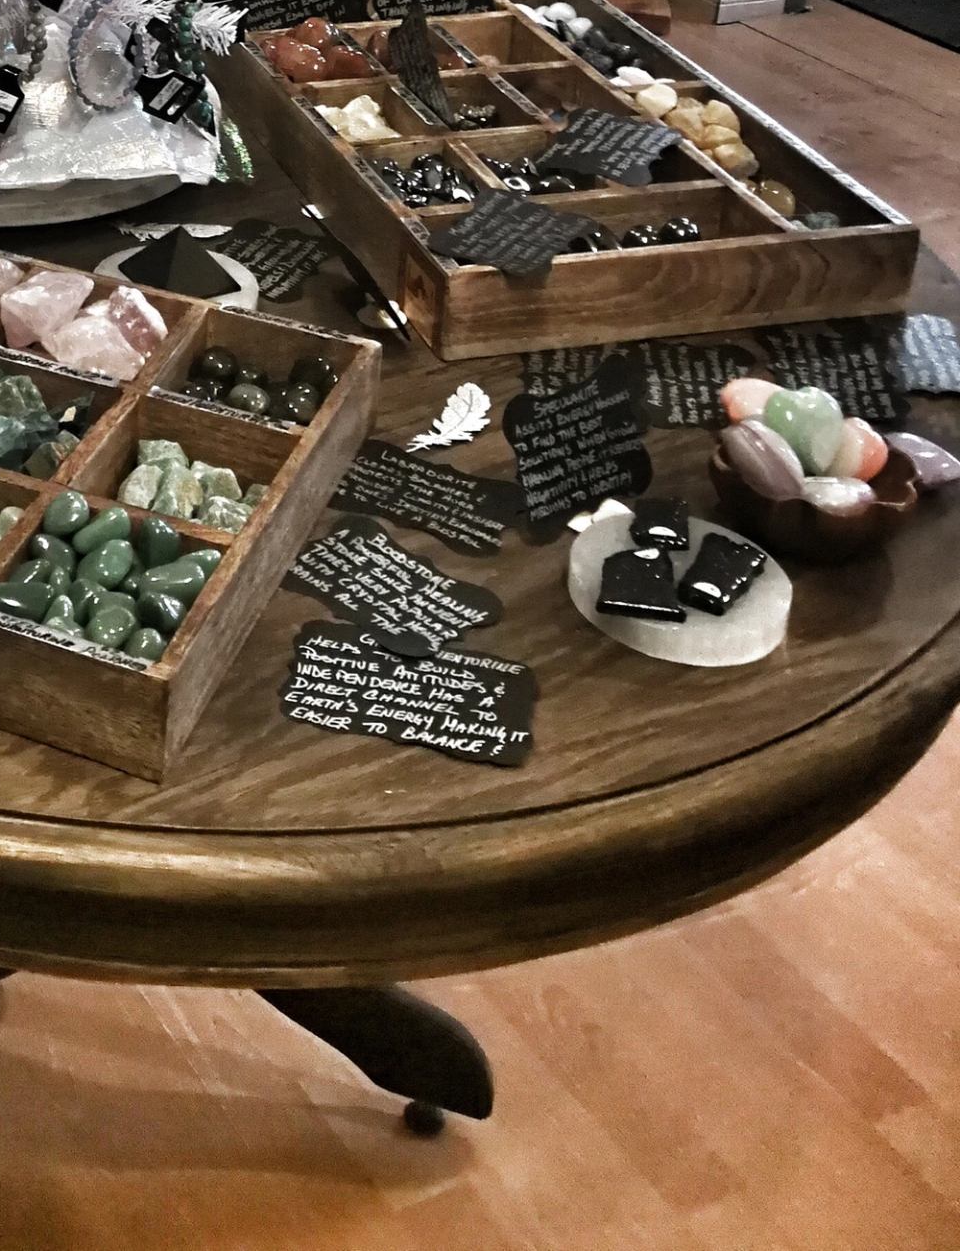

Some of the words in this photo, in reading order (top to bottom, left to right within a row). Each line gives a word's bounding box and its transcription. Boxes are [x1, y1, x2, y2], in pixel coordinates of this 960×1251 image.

[532, 432, 556, 449] FIND
[556, 426, 577, 442] THE
[380, 449, 478, 490] LABRADORITE
[407, 483, 435, 497] THE
[322, 536, 369, 567] STONE
[369, 566, 413, 594] SINCE
[408, 593, 474, 630] ANCIENT
[334, 528, 351, 539] A
[348, 536, 414, 586] POWERFUL
[418, 581, 490, 624] HEALING
[366, 532, 458, 591] BLOODSTONE
[299, 552, 336, 577] WITH
[338, 577, 403, 623] CRYSTAL
[354, 570, 390, 597] VERY
[389, 594, 459, 641] POPULAR
[334, 593, 360, 611] ALL
[371, 612, 409, 636] THE
[299, 645, 381, 673] POSITIVE
[393, 664, 487, 694] ATTITUDES
[306, 634, 361, 655] HELPS
[372, 651, 403, 663] TO
[415, 661, 476, 680] BUILD
[290, 677, 357, 698] DIRECT
[362, 689, 460, 716] CHANNEL
[469, 708, 498, 722] TO
[296, 662, 422, 696] INDEPENDENCE
[429, 688, 465, 705] HAS
[478, 696, 496, 709] A
[290, 707, 352, 731] EASIER
[362, 721, 388, 734] TO
[401, 726, 485, 754] BALANCE
[366, 704, 435, 731] ENERGY
[441, 720, 507, 744] MAKING
[510, 729, 530, 744] IT
